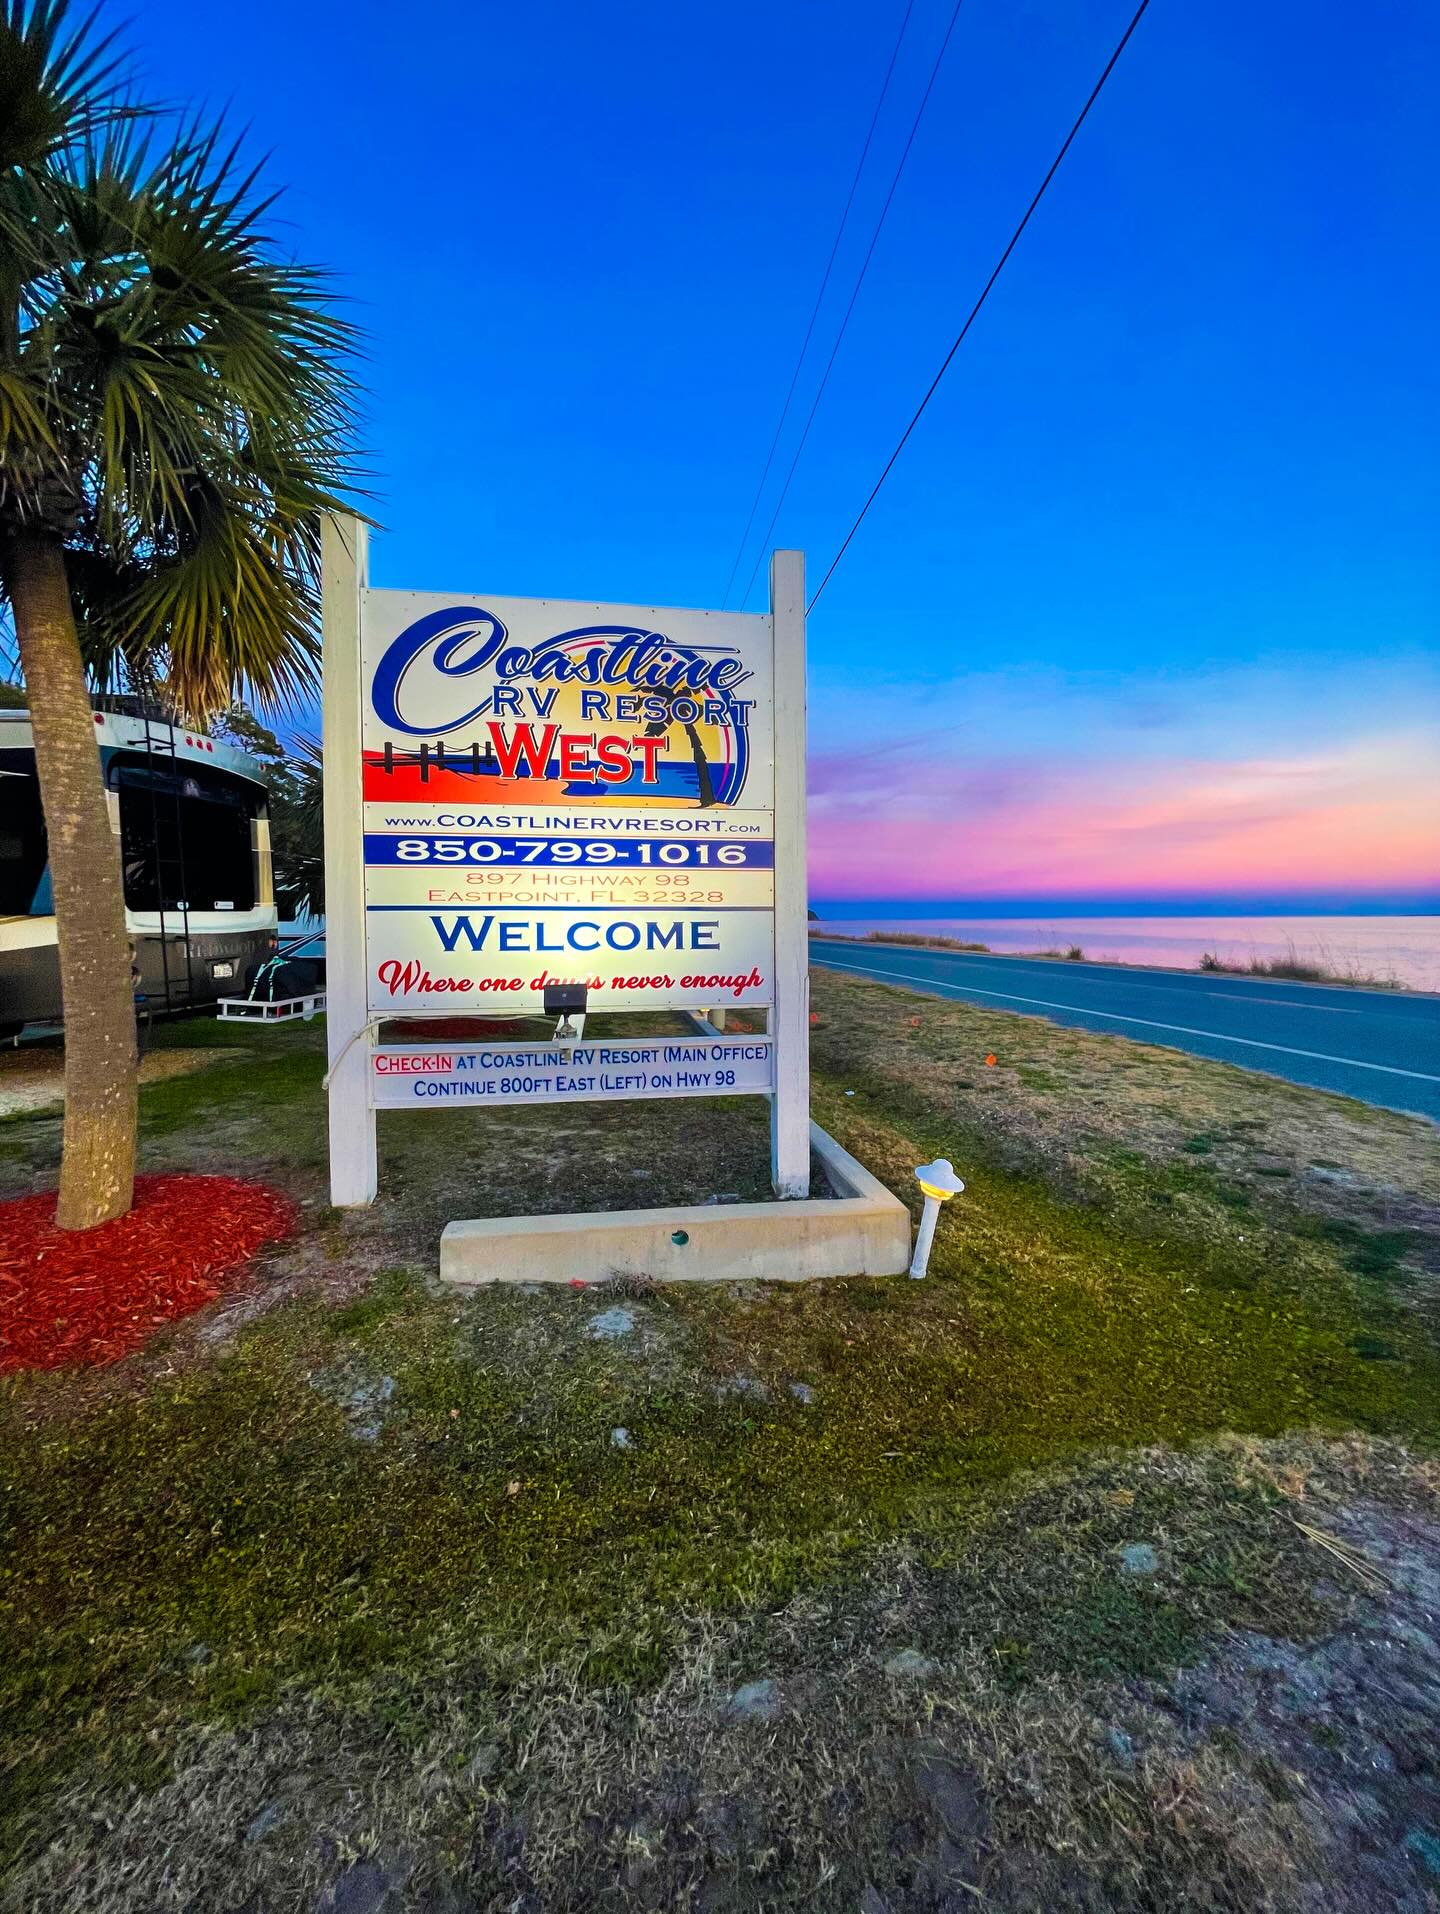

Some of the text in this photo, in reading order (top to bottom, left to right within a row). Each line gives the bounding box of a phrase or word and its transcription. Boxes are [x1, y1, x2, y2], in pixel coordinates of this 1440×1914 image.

[371, 606, 753, 737] Coastline
[491, 685, 756, 727] RV RESORT
[486, 720, 669, 784] WEST
[396, 839, 747, 865] 850-799-1016
[466, 872, 690, 886] 897 HIGHWAY 98
[592, 890, 625, 902] FL
[633, 891, 724, 902] 32328
[429, 915, 721, 952] WELCOME
[377, 959, 474, 997] Where
[478, 976, 525, 992] one
[610, 974, 676, 990] never
[679, 967, 765, 997] enough
[375, 1043, 769, 1075] CHECK-IN AT COASTLINE RV RESORT (MAIN OFFICE)
[413, 1069, 736, 1097] CONTINUE 800FT EAST (LEFT) ON HWY 98
